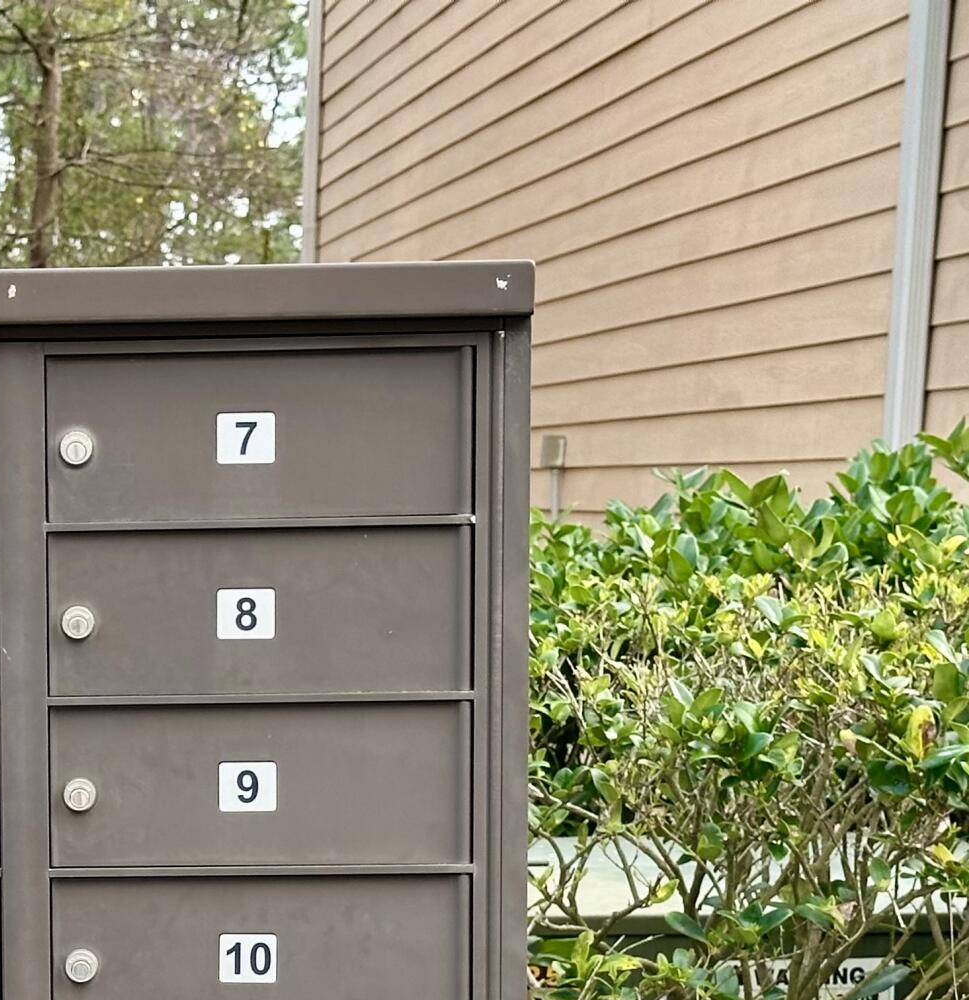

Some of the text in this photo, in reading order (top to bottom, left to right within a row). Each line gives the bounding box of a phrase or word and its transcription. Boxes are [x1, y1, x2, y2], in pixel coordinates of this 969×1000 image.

[235, 421, 258, 456] 7
[235, 597, 258, 632] 8
[236, 769, 259, 804] 9
[226, 941, 272, 976] 10
